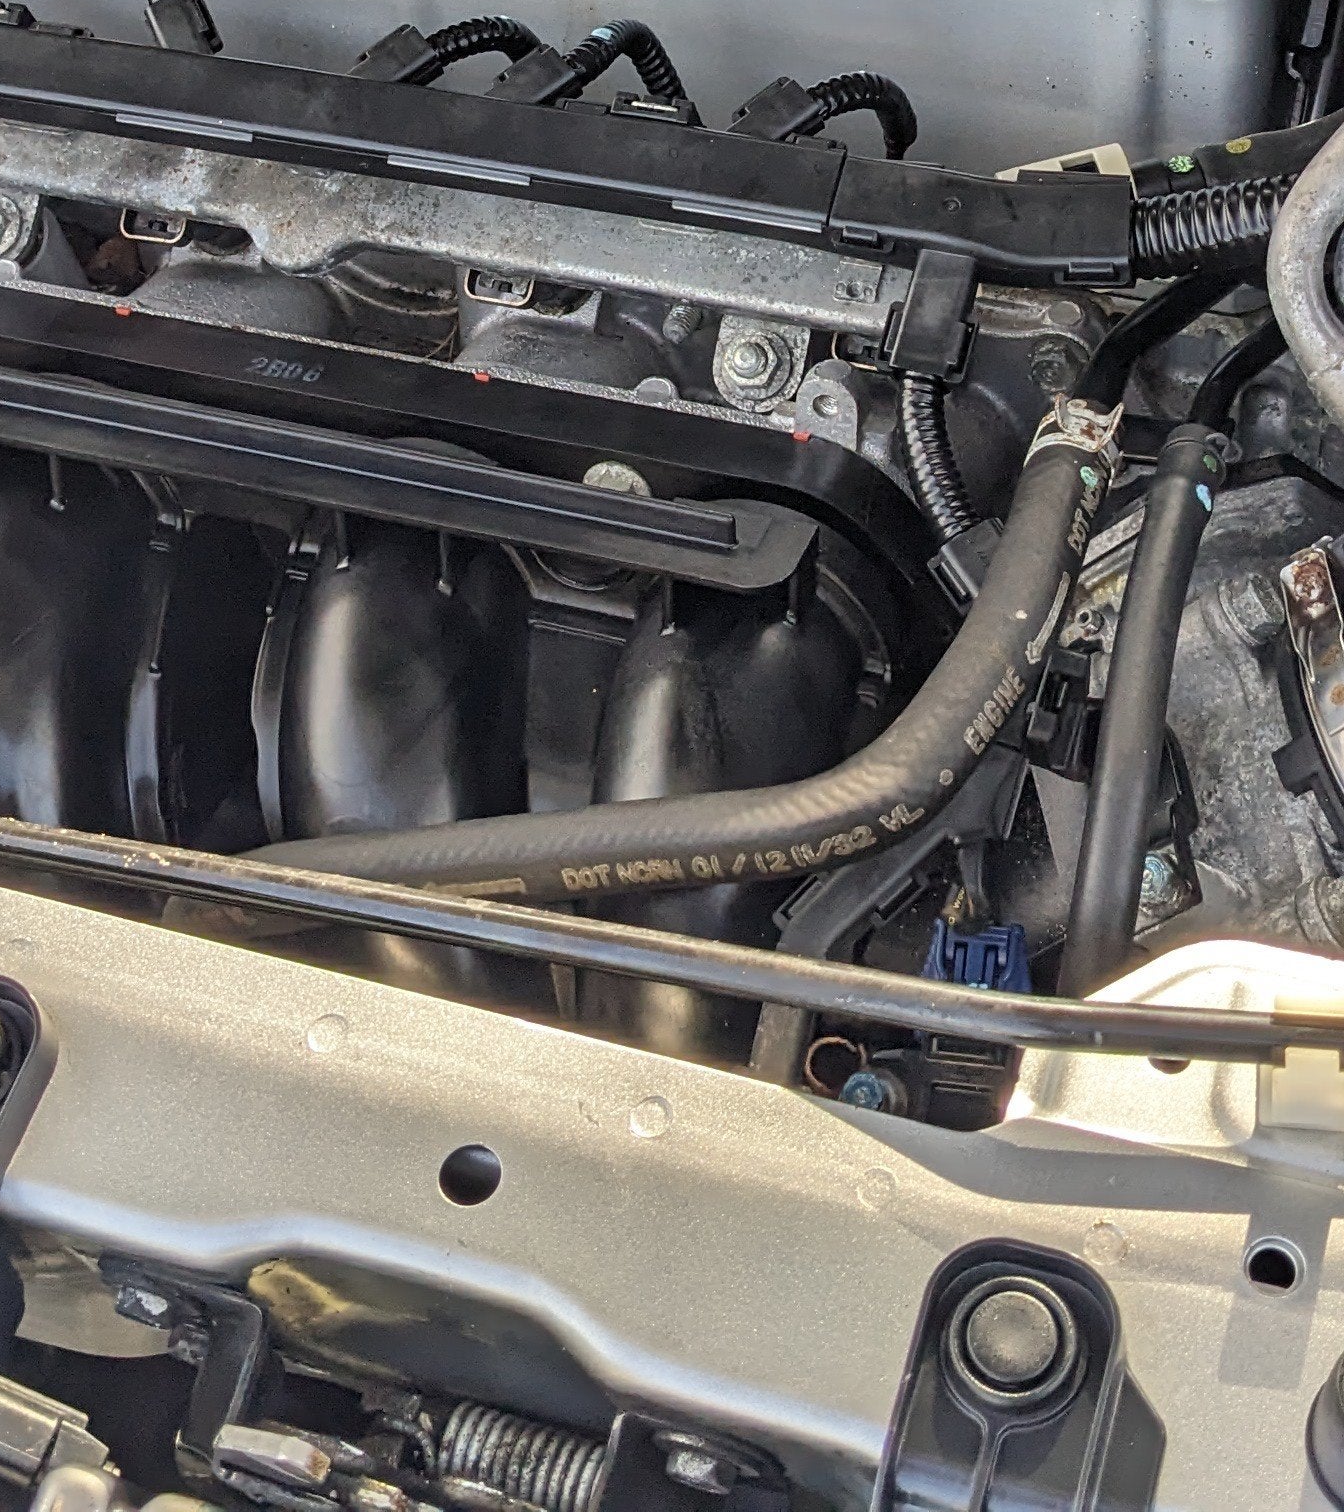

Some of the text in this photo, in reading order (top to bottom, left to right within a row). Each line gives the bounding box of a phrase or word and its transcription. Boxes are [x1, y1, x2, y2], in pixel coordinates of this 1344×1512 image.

[1068, 507, 1091, 557] DOT
[963, 666, 1026, 756] ENGINE
[560, 863, 611, 891] DOT
